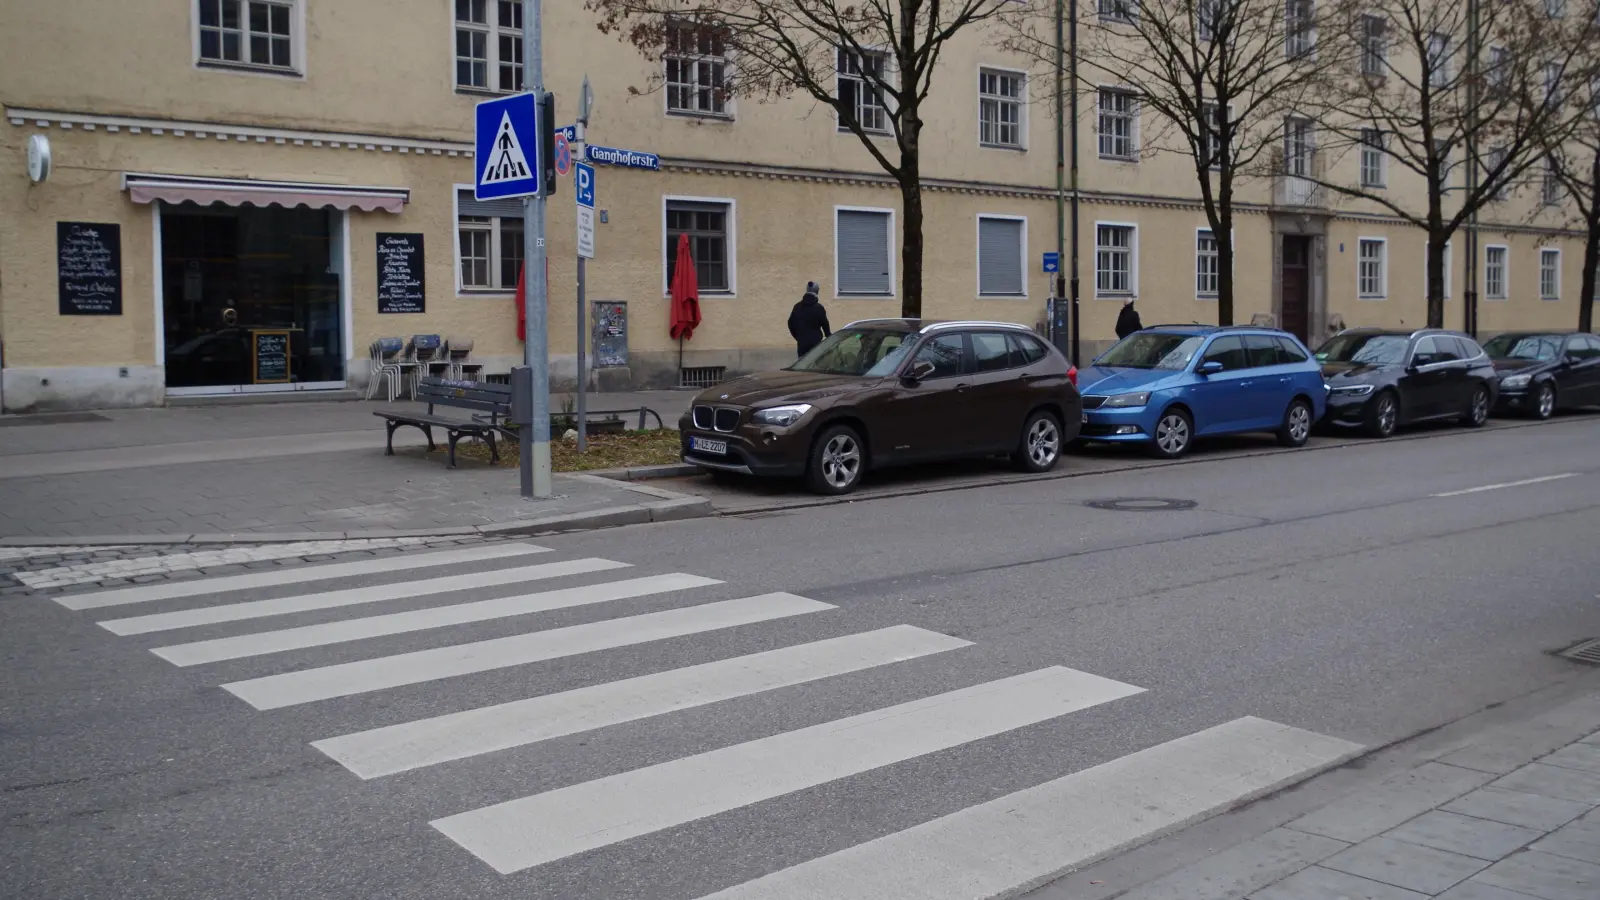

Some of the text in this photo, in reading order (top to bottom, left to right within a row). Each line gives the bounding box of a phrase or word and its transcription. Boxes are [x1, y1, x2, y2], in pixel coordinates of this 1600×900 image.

[591, 146, 657, 168] Ganghoferstr.
[579, 168, 590, 199] P
[710, 441, 726, 452] 2207
